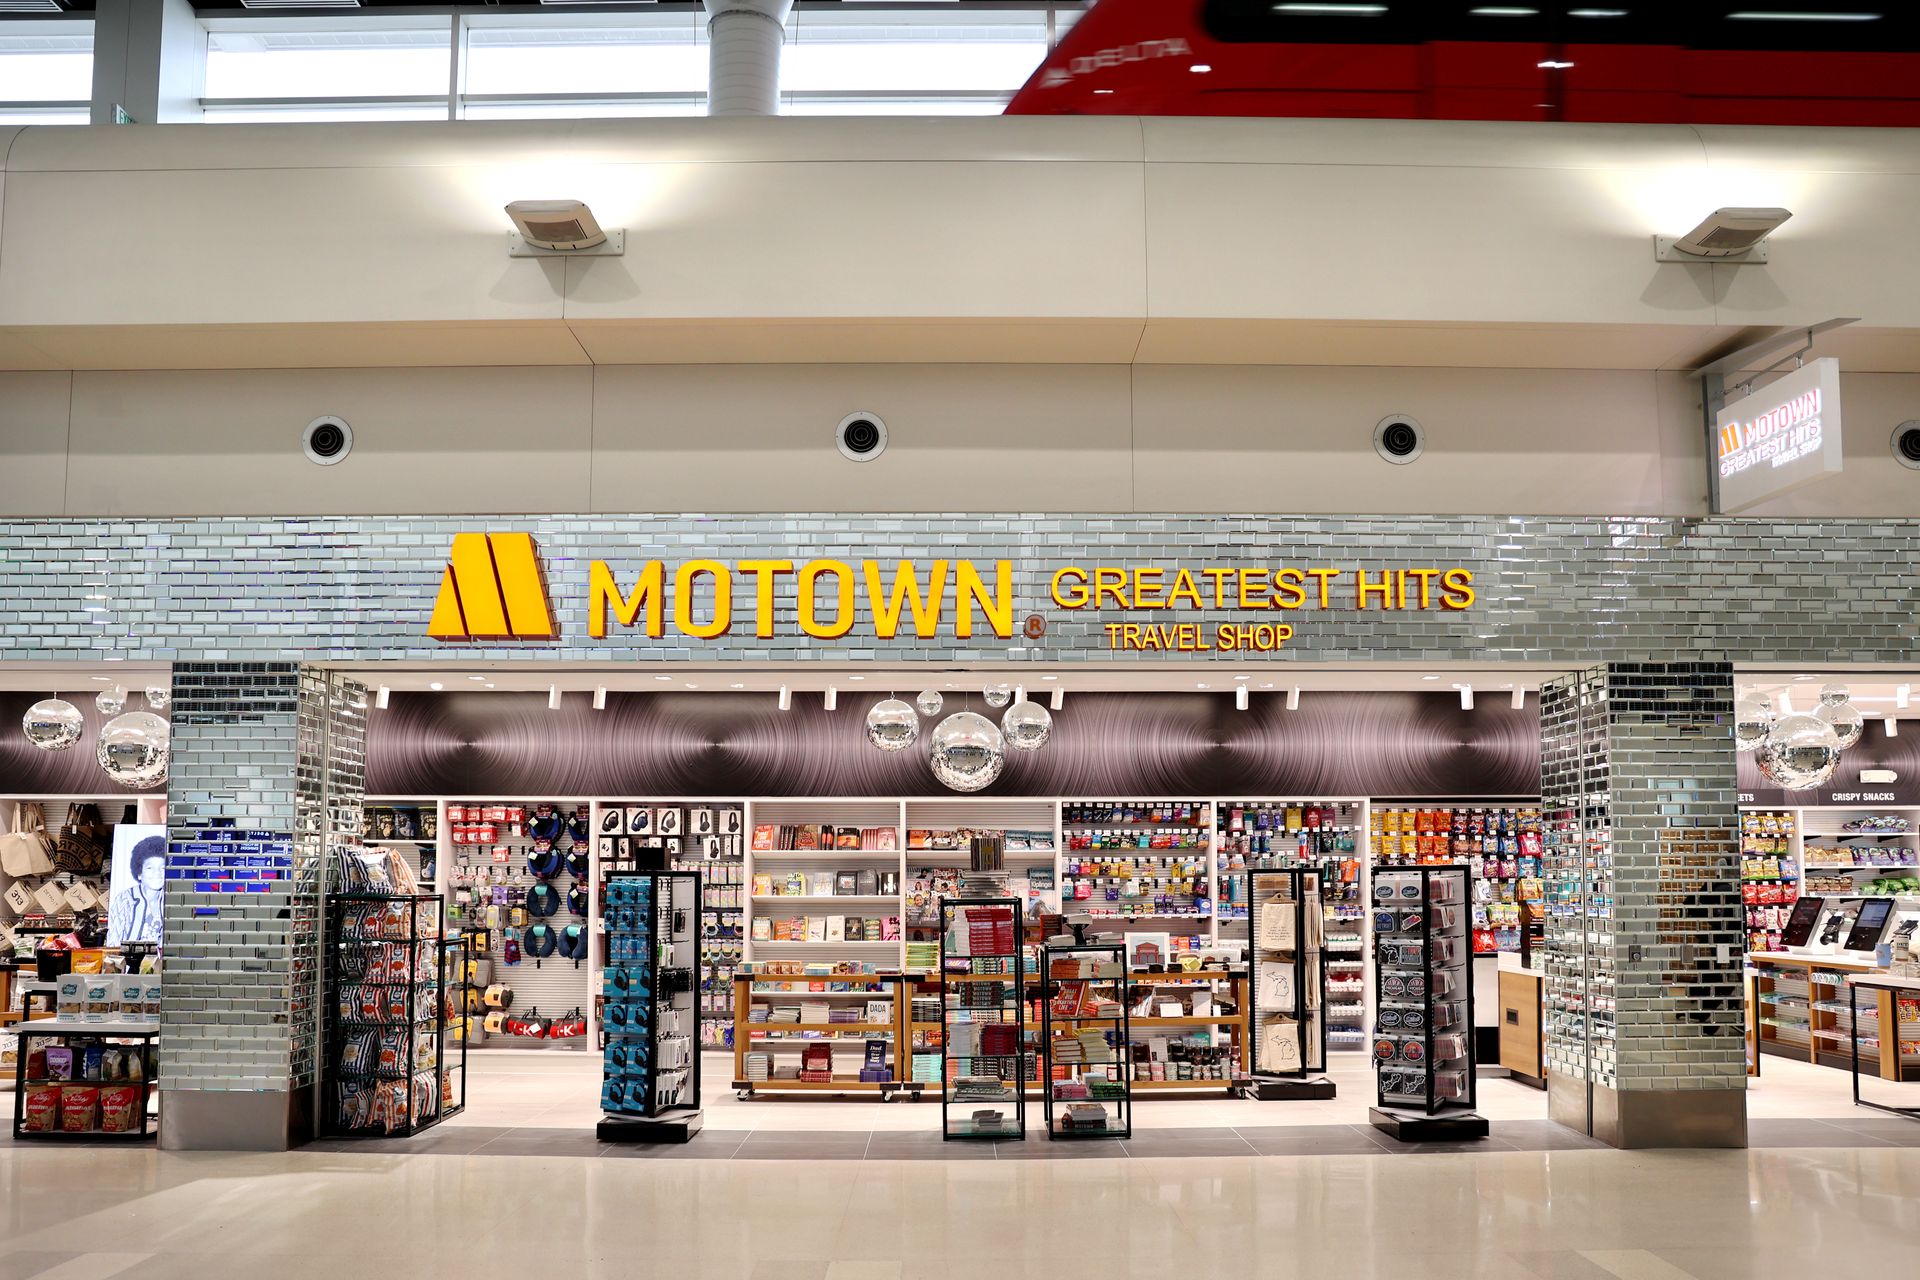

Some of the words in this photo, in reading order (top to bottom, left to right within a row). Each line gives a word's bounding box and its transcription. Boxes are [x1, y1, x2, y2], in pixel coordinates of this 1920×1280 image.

[1743, 388, 1820, 447] MOTOWN
[1720, 433, 1787, 477] GREATEST
[1787, 419, 1821, 450] HITS
[588, 560, 1014, 639] MOTOWN
[1050, 566, 1339, 610] GREATEST
[1357, 567, 1476, 611] HITS
[1104, 623, 1211, 650] TRAVEL
[1216, 622, 1294, 652] SHOP
[1832, 793, 1861, 801] CRISPY
[1863, 792, 1895, 801] SNACKS
[11, 889, 24, 906] 313
[869, 1004, 886, 1013] DADA
